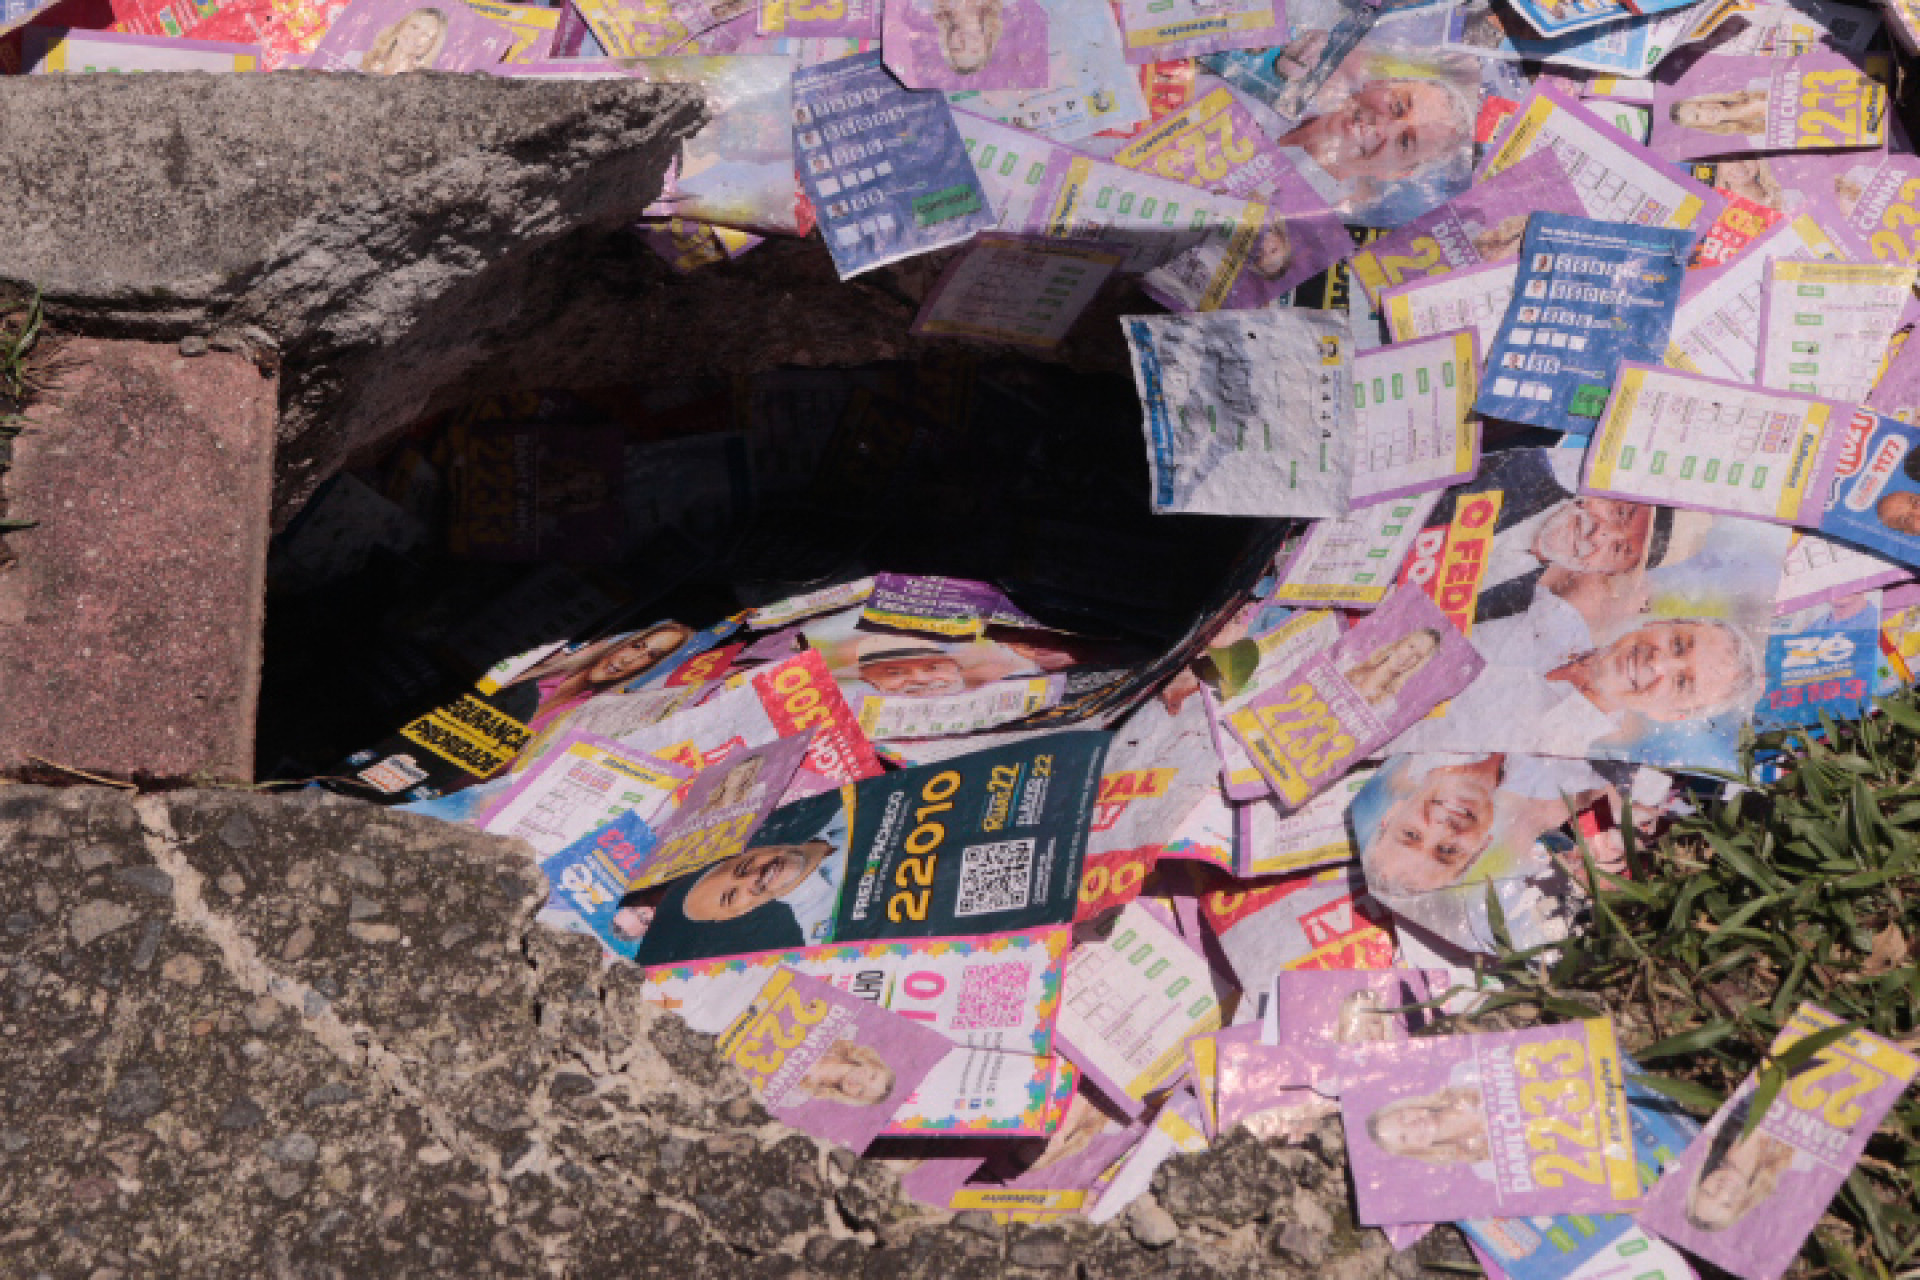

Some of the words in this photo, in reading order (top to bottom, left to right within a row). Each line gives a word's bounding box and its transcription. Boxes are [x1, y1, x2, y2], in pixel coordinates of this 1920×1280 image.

[1147, 111, 1254, 184] 223
[1461, 498, 1494, 528] O
[1258, 683, 1356, 778] 2233
[852, 874, 876, 920] FRED
[869, 790, 905, 864] PACHECO
[888, 770, 961, 924] 22010
[1078, 860, 1146, 904] 00
[852, 969, 884, 1001] LHO
[899, 971, 945, 1022] 10
[1490, 1045, 1520, 1129] CUNHA
[1514, 1038, 1606, 1188] 2233
[1502, 1129, 1532, 1193] DANI
[1786, 1111, 1849, 1151] DANI
